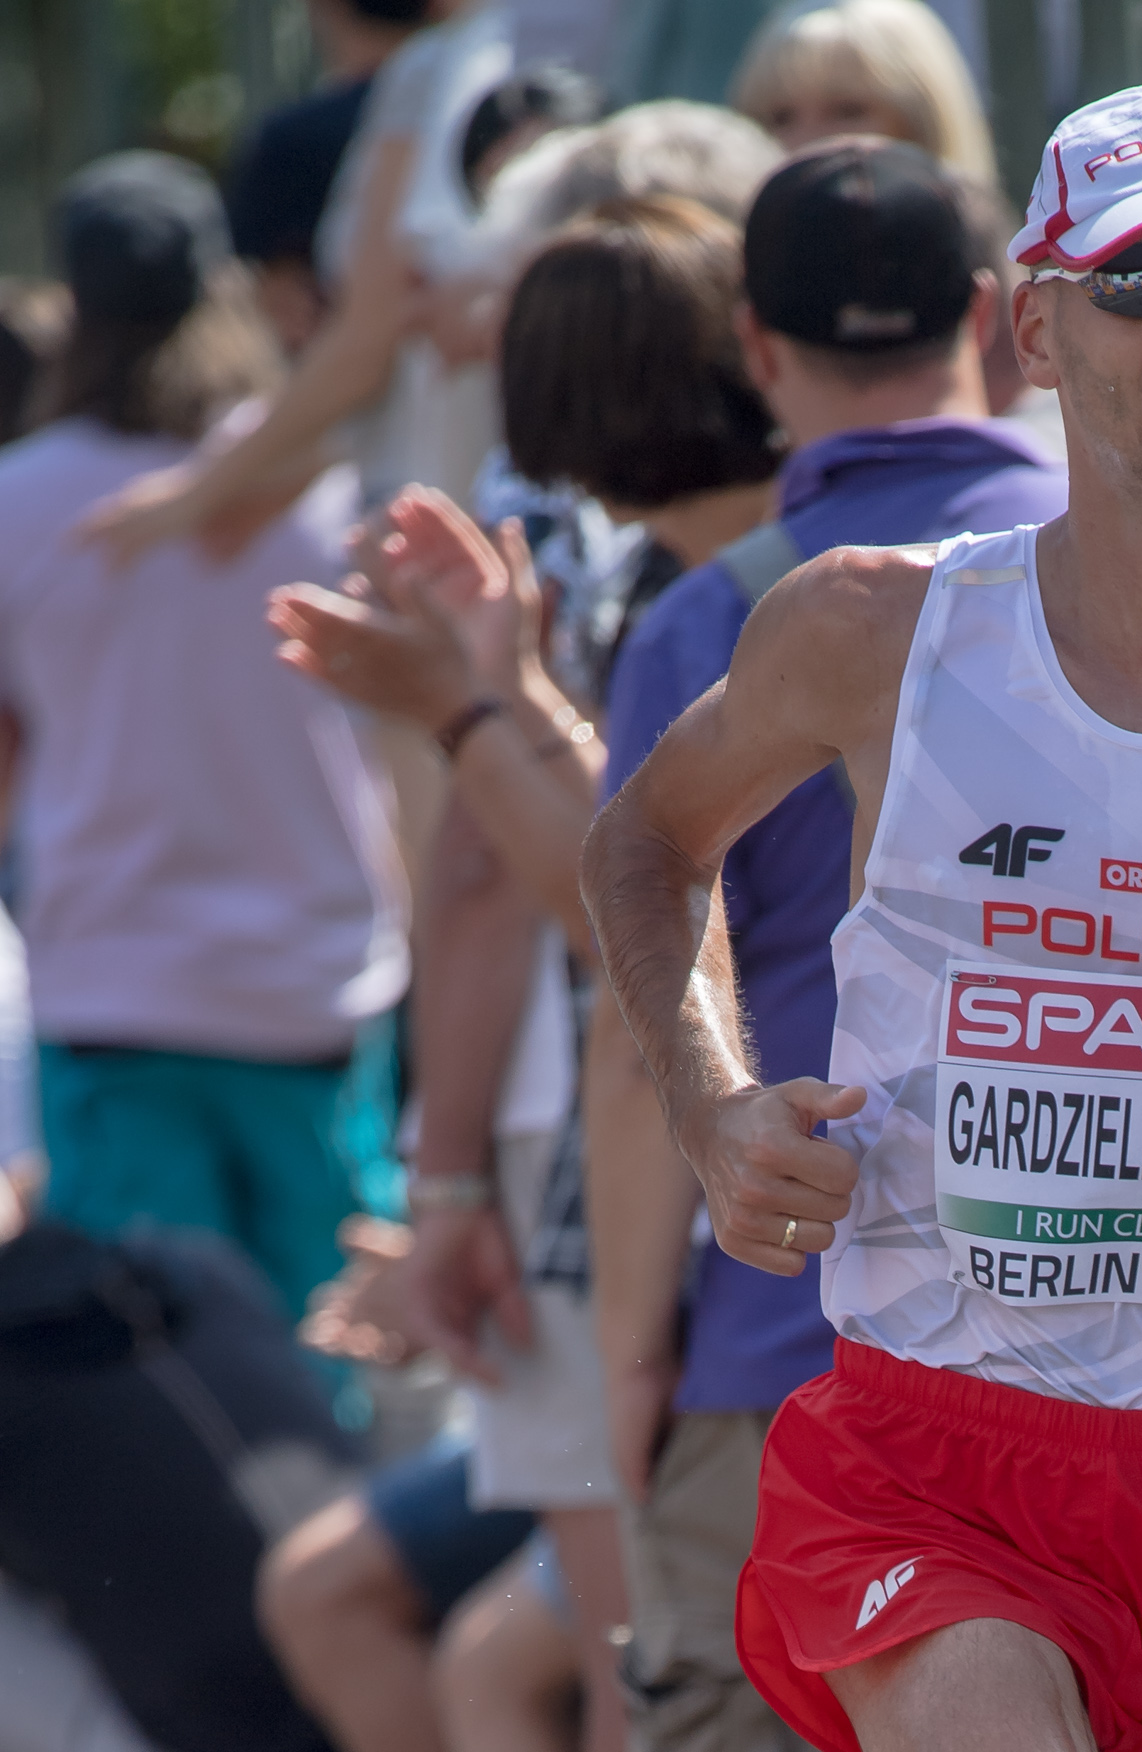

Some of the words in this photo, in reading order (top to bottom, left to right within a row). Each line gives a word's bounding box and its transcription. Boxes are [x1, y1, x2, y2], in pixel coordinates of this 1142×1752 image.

[958, 823, 1066, 878] 4F
[1015, 1210, 1024, 1236] I
[1034, 1212, 1103, 1239] RUN
[969, 1245, 1141, 1299] BERLIN
